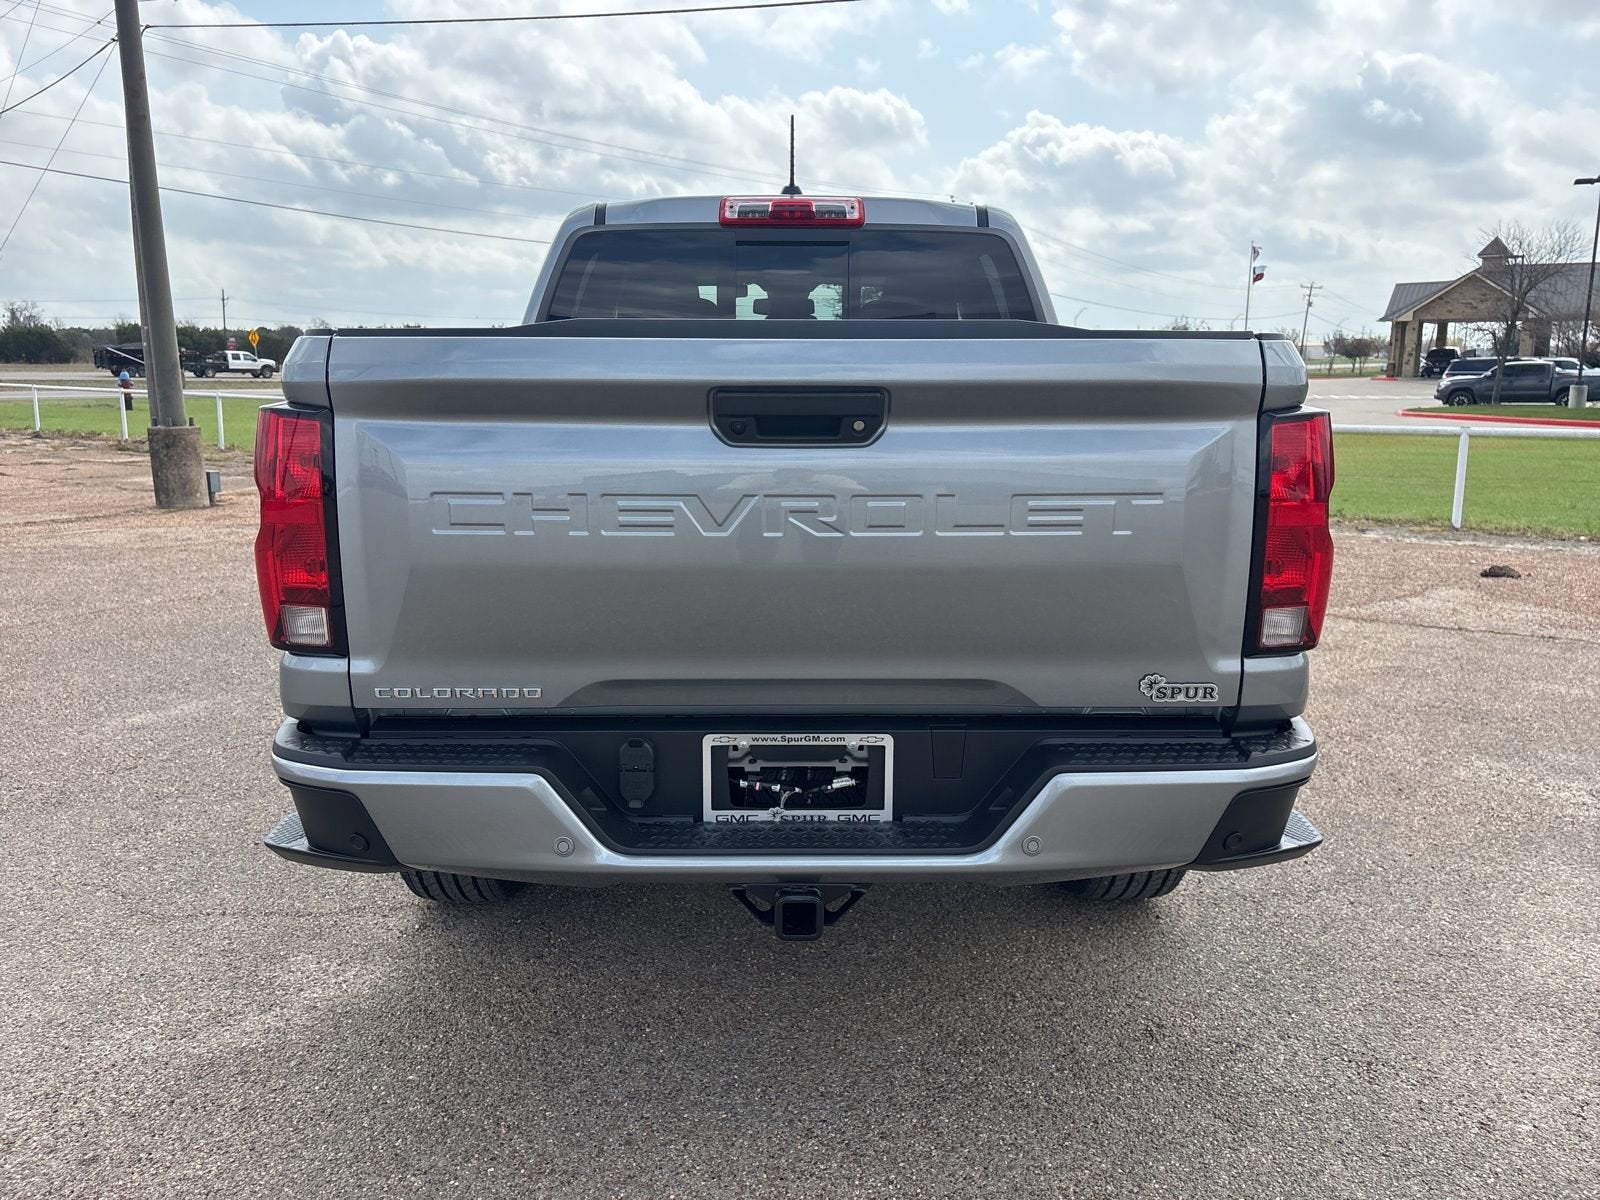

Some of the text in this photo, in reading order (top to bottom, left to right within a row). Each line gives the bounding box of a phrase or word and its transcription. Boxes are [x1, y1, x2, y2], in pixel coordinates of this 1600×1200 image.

[430, 492, 1164, 537] CHEVROLET
[374, 687, 542, 699] COLORADO
[1155, 685, 1217, 700] SPUR
[751, 735, 846, 744] www.SpurGM.com
[715, 814, 759, 822] GMC
[837, 814, 881, 822] GMC
